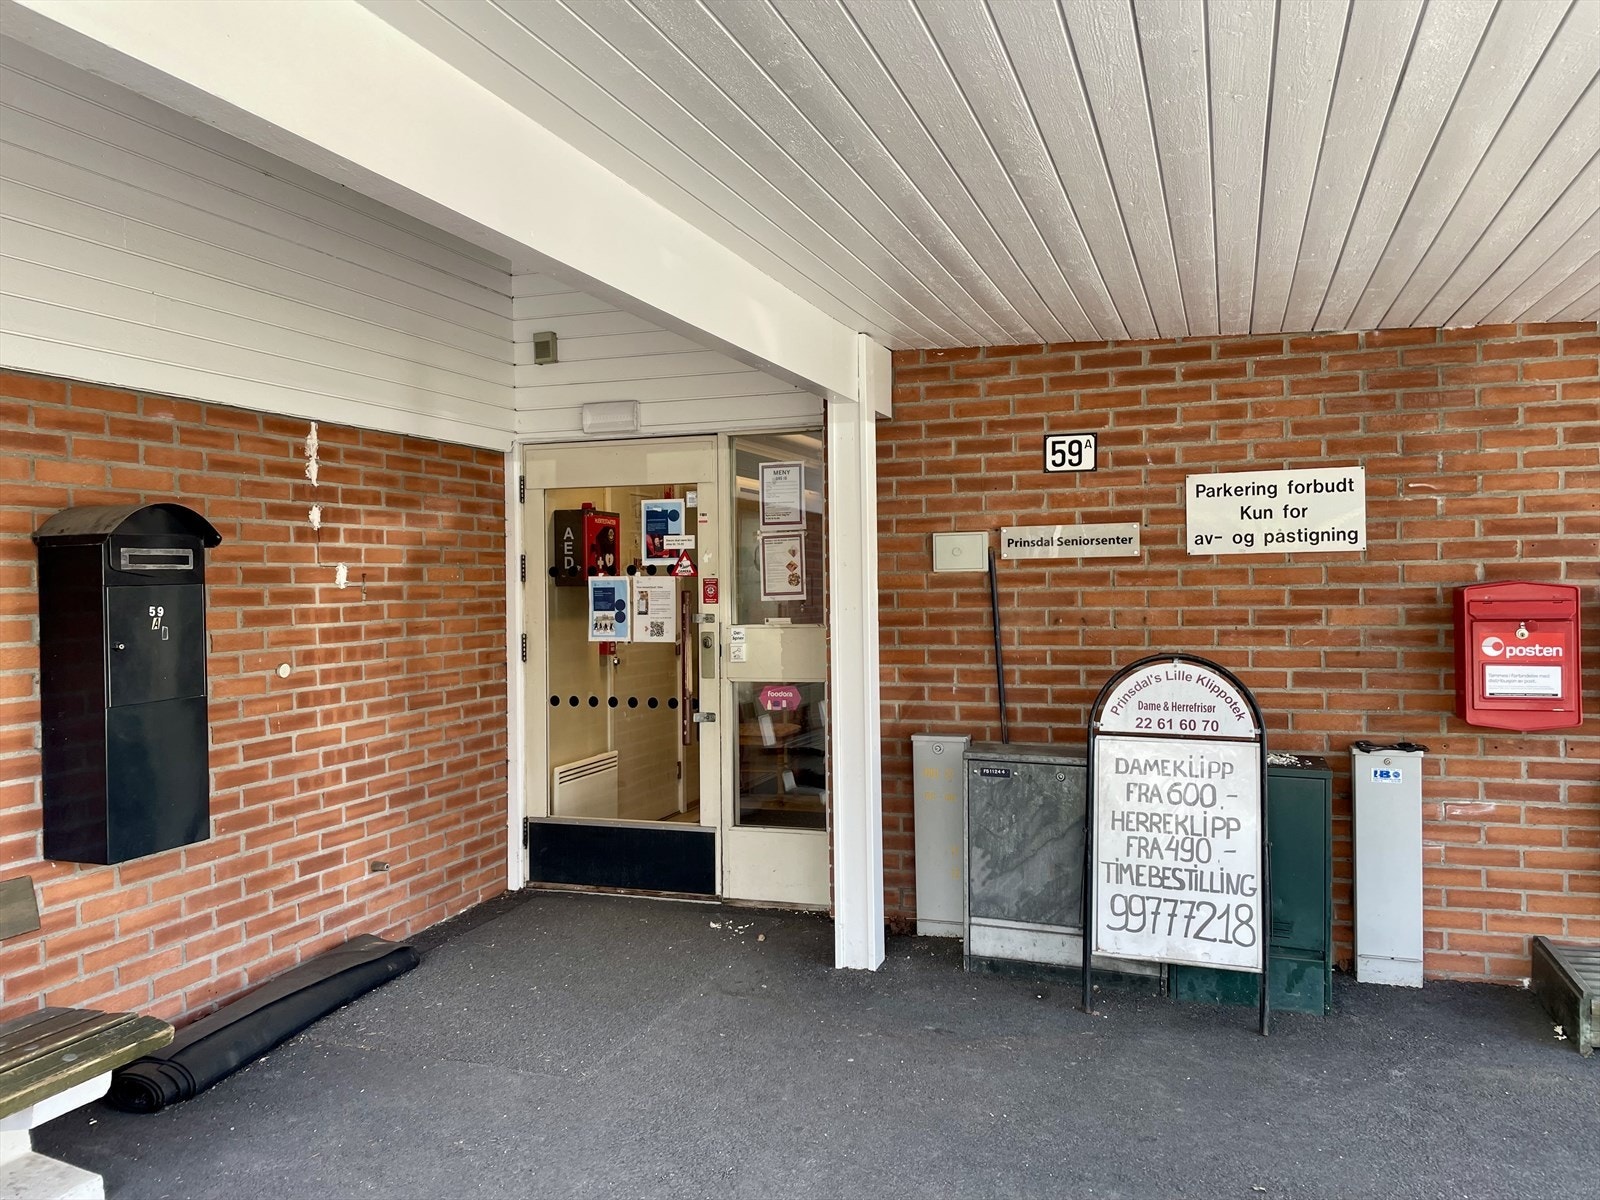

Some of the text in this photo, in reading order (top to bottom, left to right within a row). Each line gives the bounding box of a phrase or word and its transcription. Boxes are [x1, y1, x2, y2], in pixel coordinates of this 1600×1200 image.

[1195, 477, 1355, 498] Parkering forbudt
[1240, 504, 1308, 520] Kun for
[1007, 536, 1134, 548] Prinsdal Seniorsenter
[1194, 527, 1358, 547] av- og påstigning
[563, 527, 575, 570] AED
[148, 605, 165, 617] 59
[1505, 644, 1563, 659] posten
[1110, 670, 1246, 722] Prinsdal's Lille Klippotek
[1137, 700, 1216, 714] Dame & Herrefrisør
[1135, 717, 1219, 732] 22 61 60 70
[1126, 782, 1163, 804] FRA
[1126, 836, 1164, 861] FRA
[1106, 893, 1257, 948] 99777218
